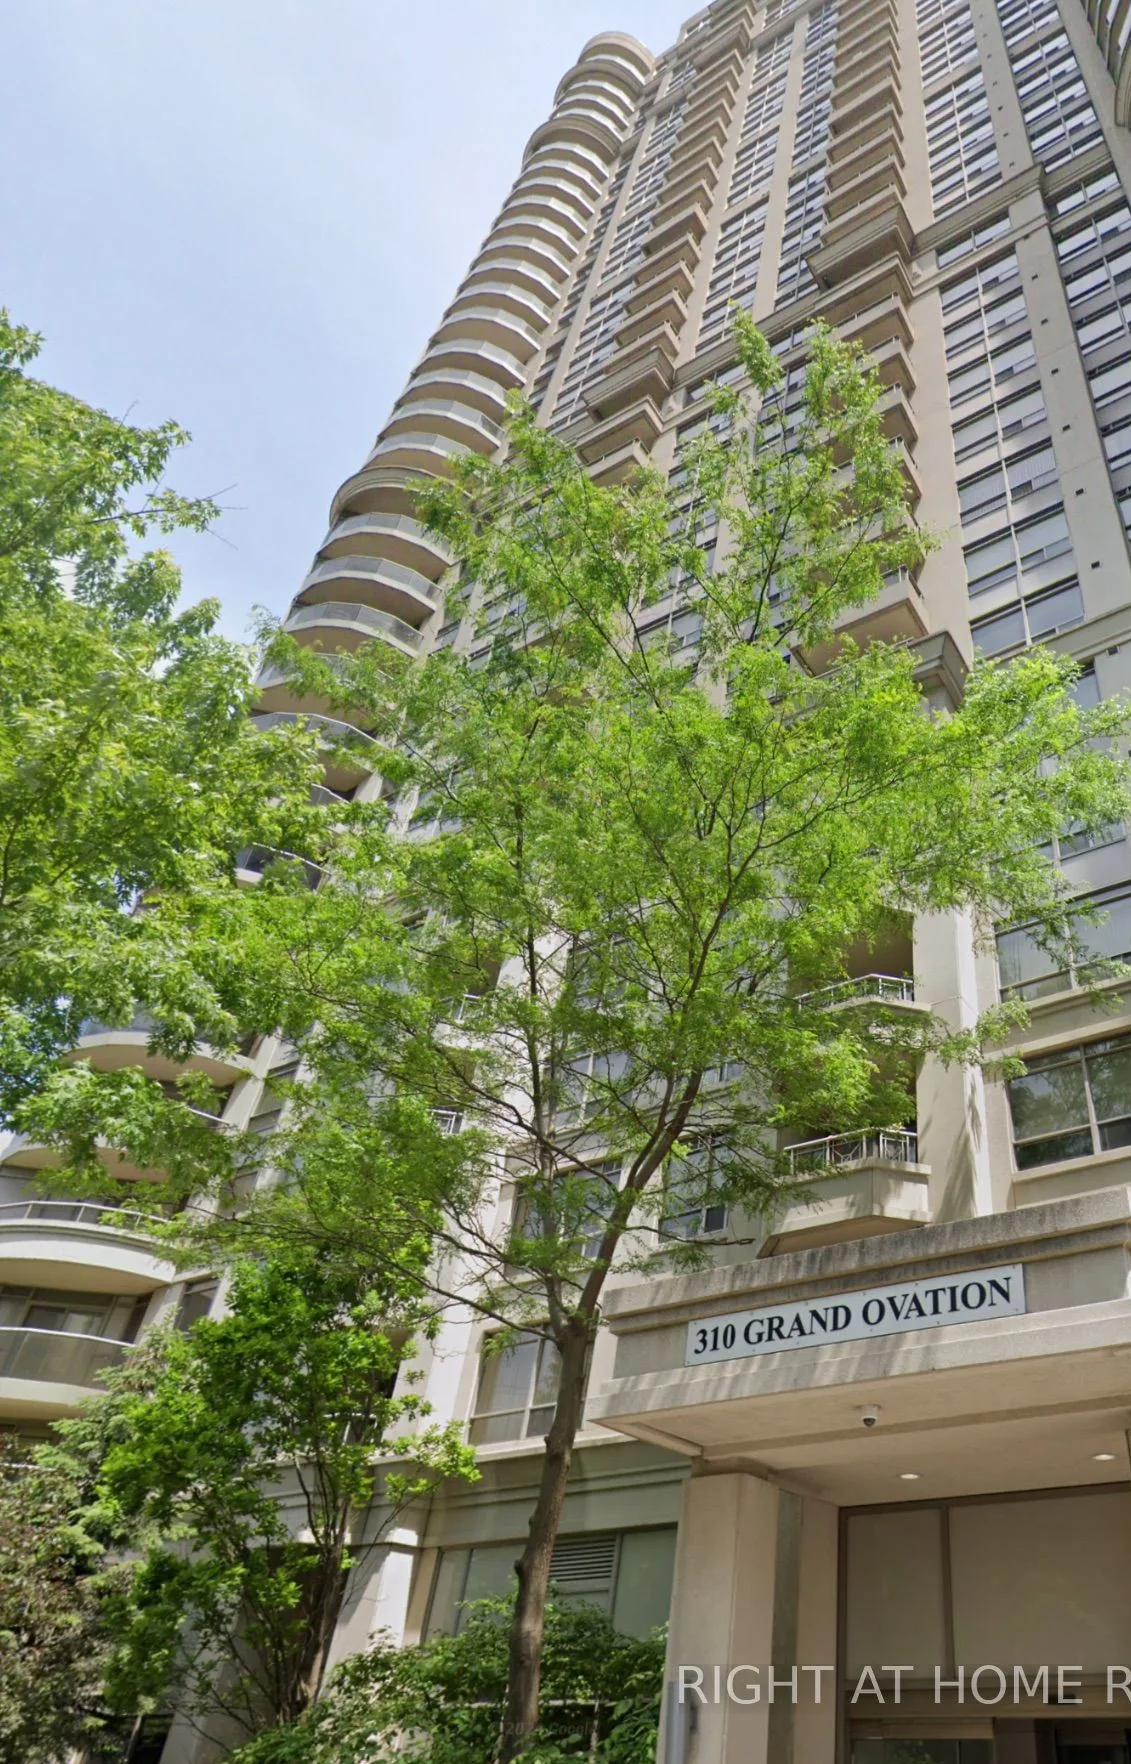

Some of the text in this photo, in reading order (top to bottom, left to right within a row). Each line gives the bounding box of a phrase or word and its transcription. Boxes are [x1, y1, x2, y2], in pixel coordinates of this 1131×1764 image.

[694, 1277, 1012, 1354] 310 GRAND OVATION
